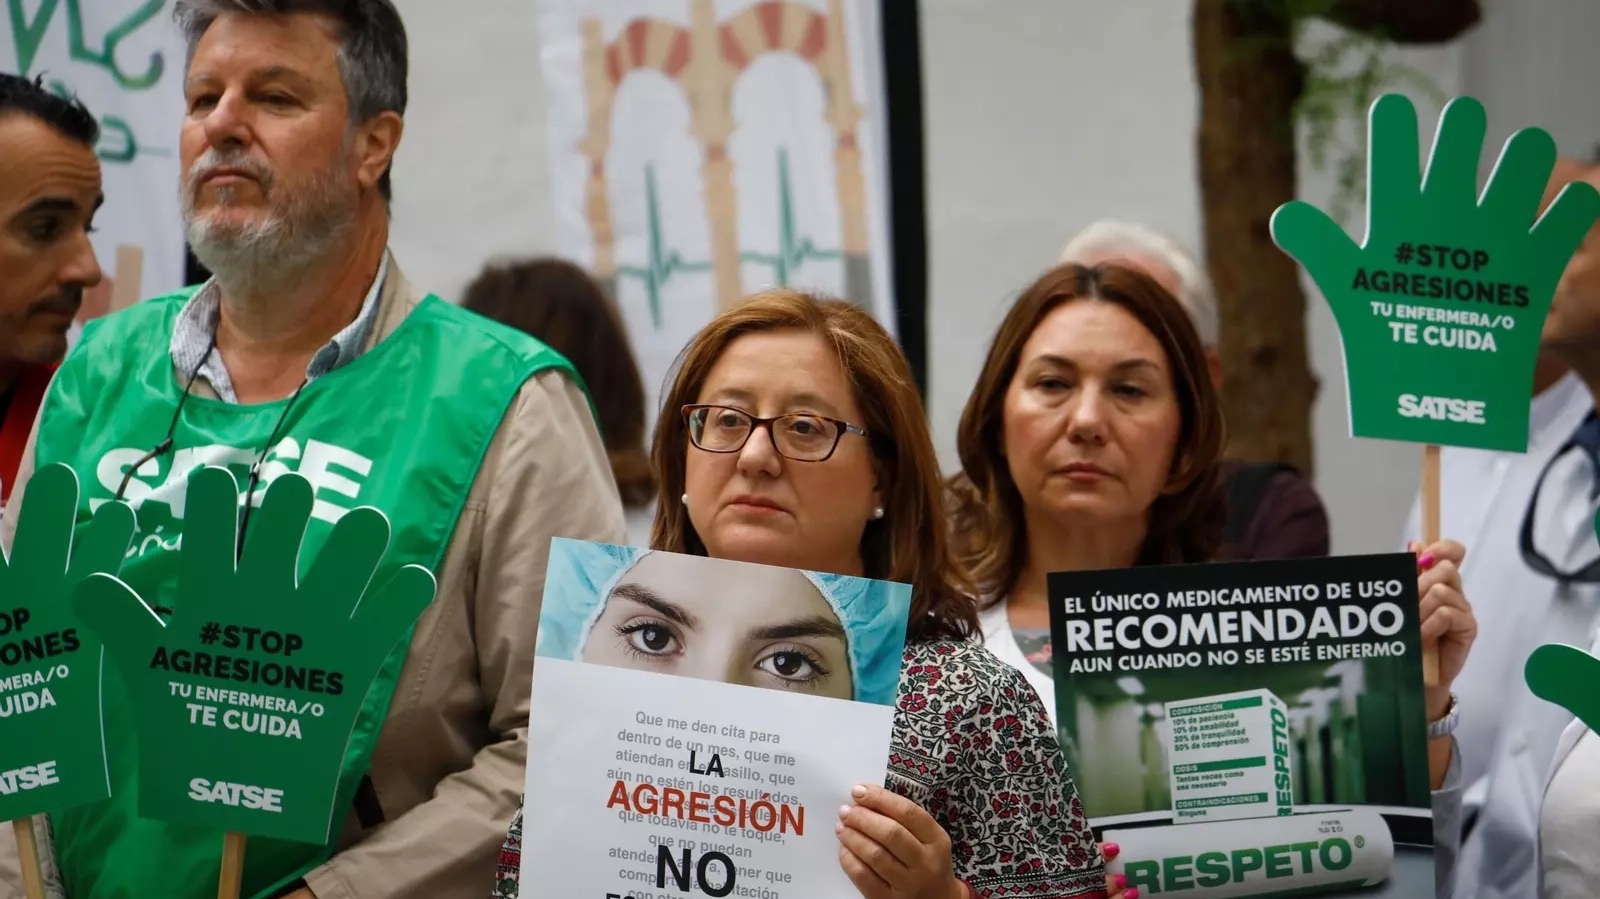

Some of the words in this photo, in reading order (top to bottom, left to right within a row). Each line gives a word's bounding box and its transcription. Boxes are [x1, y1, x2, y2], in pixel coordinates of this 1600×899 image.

[1394, 242, 1489, 271] #STOP
[1352, 268, 1530, 308] AGRESIONES
[1370, 301, 1393, 317] TU
[1396, 304, 1515, 330] ENFERMERA/O
[1389, 322, 1418, 344] TE
[1423, 326, 1497, 352] CUIDA
[1397, 393, 1486, 424] SATSE
[1064, 597, 1086, 614] EL
[1091, 590, 1160, 612] ÚNICO
[1166, 583, 1319, 609] MEDICAMENTO
[1326, 582, 1351, 599] DE
[1358, 579, 1402, 597] USO
[199, 622, 303, 657] #STOP
[1065, 602, 1404, 652] RECOMENDADO
[149, 646, 344, 696] AGRESIONES
[1069, 657, 1112, 674] AUN
[1118, 651, 1201, 671] CUANDO
[1207, 650, 1239, 666] NO
[1244, 648, 1265, 665] SE
[1271, 641, 1311, 663] ESTÉ
[1317, 641, 1405, 660] ENFERMO
[0, 665, 69, 692] MERA/O
[0, 687, 57, 718] UIDA
[169, 681, 192, 699] TU
[195, 685, 324, 718] ENFERMERA/O
[186, 703, 217, 727] TE
[223, 709, 302, 739] CUIDA
[636, 711, 663, 726] Que
[667, 718, 687, 730] me
[691, 720, 717, 734] den
[721, 725, 745, 739] cita
[749, 730, 780, 744] para
[617, 729, 661, 746] dentro
[666, 736, 682, 749] de
[686, 741, 703, 753] un
[707, 744, 739, 760] mes,
[744, 749, 770, 763] que
[774, 754, 795, 766] me
[689, 750, 725, 778] LA
[1270, 707, 1292, 816] RESPETO
[607, 767, 632, 781] aún
[636, 773, 653, 785] no
[657, 777, 694, 791] estén
[698, 780, 719, 795] los
[615, 749, 674, 768] atiendan
[769, 773, 795, 786] que
[188, 777, 284, 813] SATSE
[606, 780, 805, 836] AGRESIÓN
[618, 810, 643, 823] que
[702, 823, 720, 834] no
[725, 825, 737, 836] te
[741, 828, 785, 845] toque,
[648, 834, 674, 847] que
[679, 839, 696, 850] no
[700, 840, 752, 858] puedan
[656, 844, 736, 898] NO
[765, 870, 792, 884] que
